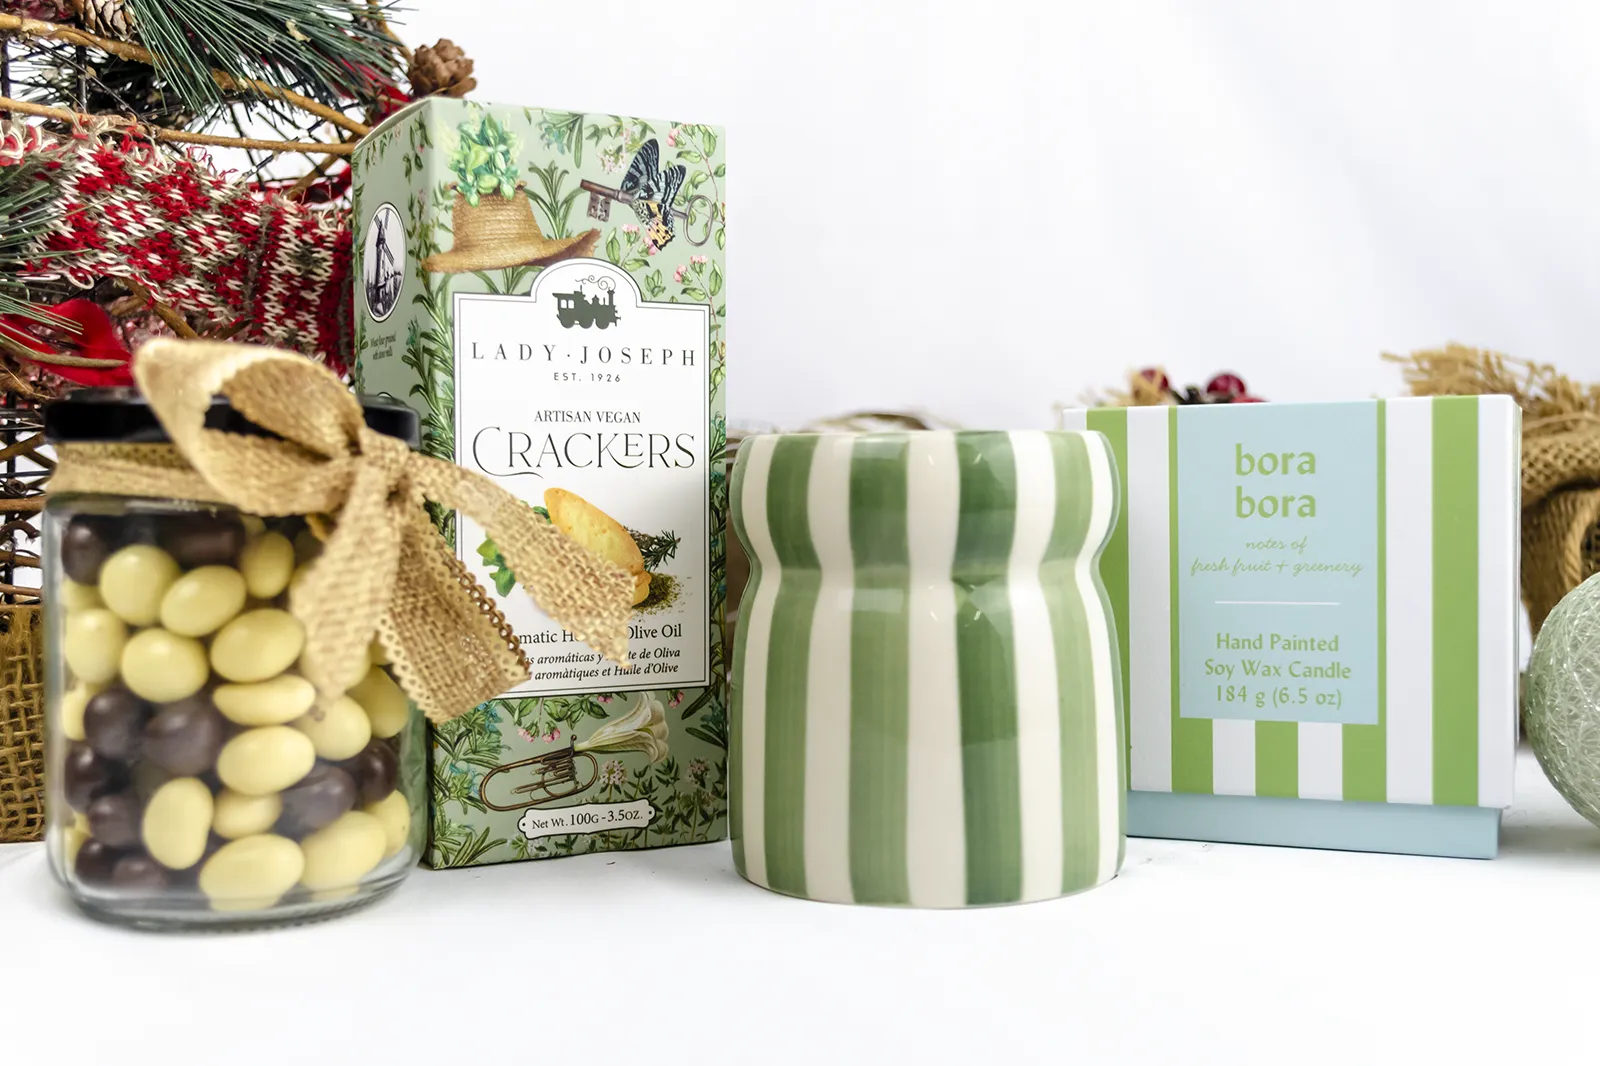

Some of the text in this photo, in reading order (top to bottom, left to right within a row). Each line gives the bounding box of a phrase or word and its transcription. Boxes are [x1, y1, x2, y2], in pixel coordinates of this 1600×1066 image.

[472, 342, 696, 366] LADY JOSEPH
[554, 372, 621, 382] EST. 1926
[534, 410, 641, 424] ARTISAN VEGAN
[472, 426, 695, 479] CRACKERS
[1236, 443, 1316, 476] bora
[1236, 486, 1316, 518] bora
[1246, 536, 1308, 554] notes of
[1190, 558, 1230, 576] fresh
[1232, 558, 1272, 577] fruit
[1293, 562, 1363, 578] greenery
[519, 630, 558, 644] matic
[661, 623, 682, 638] Oil
[1216, 632, 1339, 652] Hand Painted
[537, 652, 595, 664] aromáticas
[639, 648, 652, 660] de
[653, 646, 681, 659] Oliva
[534, 666, 600, 682] aromàtiques
[602, 668, 612, 676] et
[1204, 658, 1352, 680] Soy Wax Candle
[1216, 684, 1343, 710] 184 g (6.5 oz)
[532, 820, 548, 830] Net
[551, 817, 568, 828] Wt.
